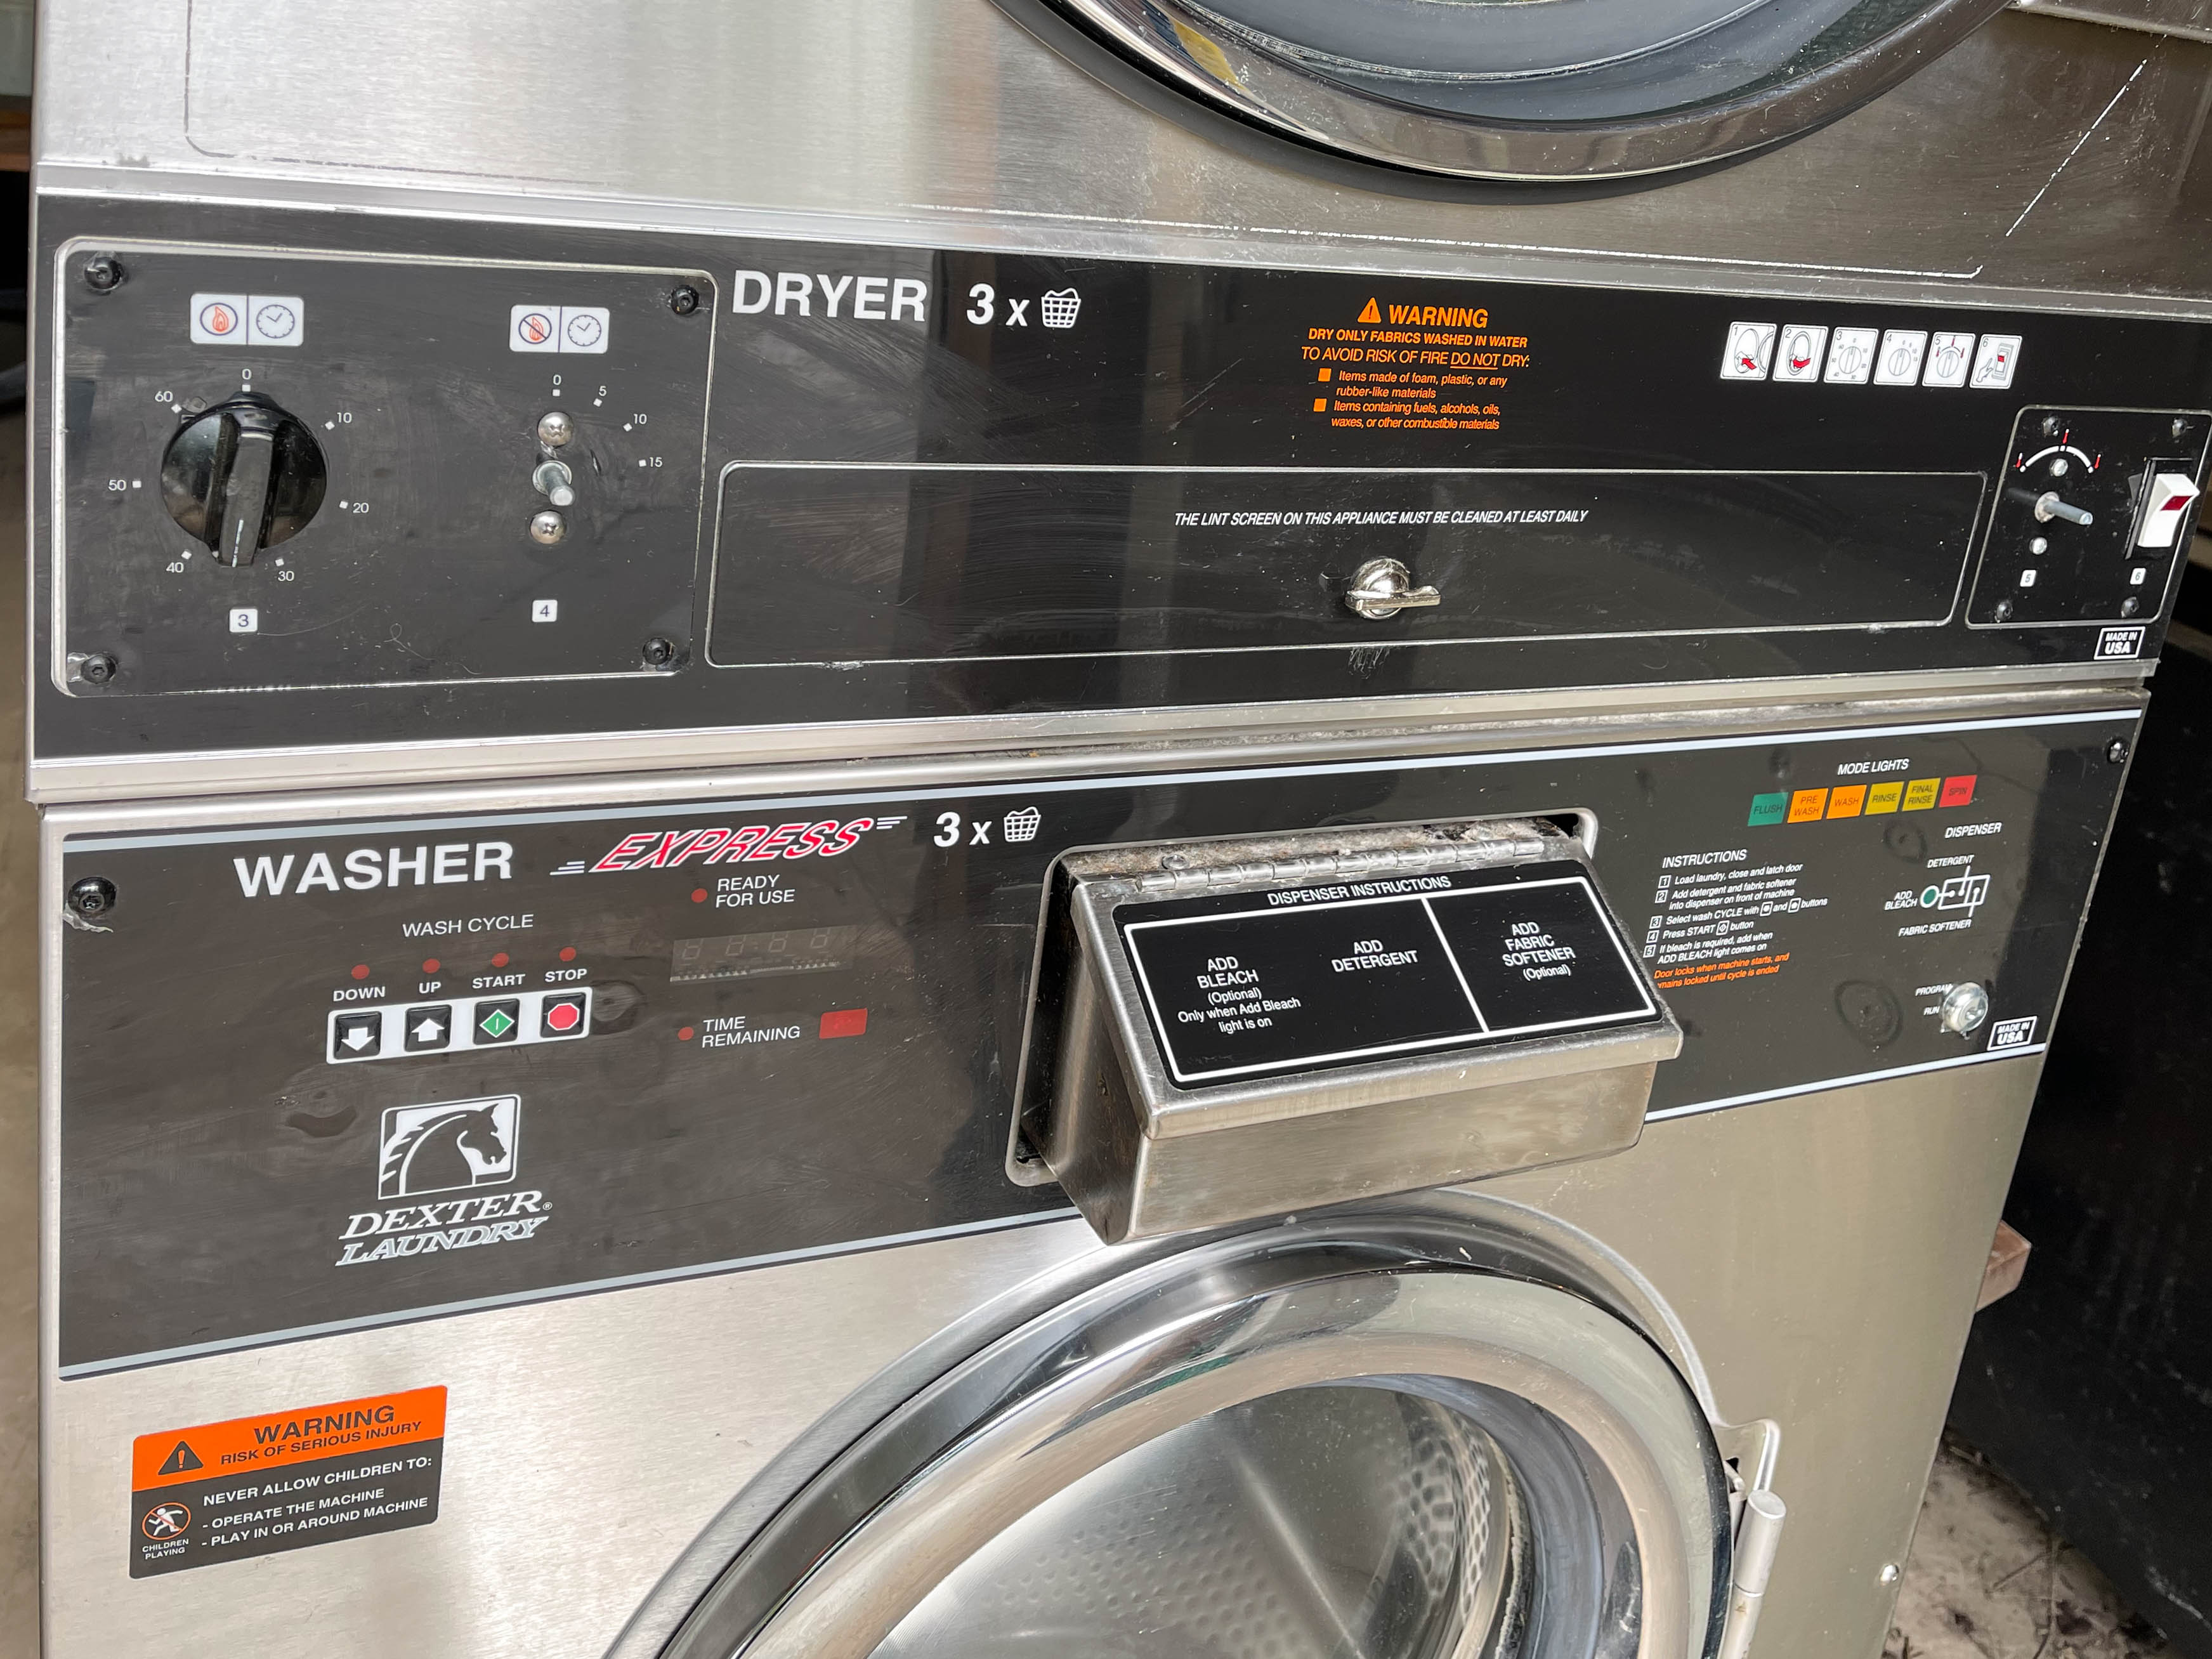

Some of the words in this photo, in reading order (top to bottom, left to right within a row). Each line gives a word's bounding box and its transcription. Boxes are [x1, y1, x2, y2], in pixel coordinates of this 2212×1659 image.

[733, 270, 927, 322] DRYER
[967, 283, 995, 325] 3
[1005, 298, 1030, 326] x
[1389, 304, 1488, 328] WARNING
[1308, 327, 1334, 340] DRY
[1336, 329, 1368, 341] ONLY
[1370, 331, 1421, 344] FABRICS
[1423, 332, 1473, 346] WASHED
[1474, 334, 1487, 346] IN
[1489, 335, 1528, 348] WATER
[1302, 346, 1320, 360] TO
[1321, 347, 1363, 362] AVOID
[1365, 349, 1397, 363] RISK
[1399, 350, 1418, 364] OF
[1420, 351, 1449, 364] FIRE
[1450, 351, 1471, 365] DO
[1472, 353, 1501, 366] NOT
[1502, 353, 1529, 367] DRY:
[242, 369, 251, 379] 0
[553, 375, 561, 385] 0
[1338, 370, 1366, 381] Items
[1368, 371, 1397, 383] made
[1399, 372, 1410, 383] of
[1411, 372, 1438, 385] foam,
[1441, 373, 1474, 386] plastic,
[1477, 376, 1488, 385] or
[1489, 377, 1508, 388] any
[155, 391, 173, 402] 60
[599, 385, 606, 397] 5
[1336, 386, 1389, 397] rubber-like
[1391, 389, 1436, 398] materials
[1333, 400, 1361, 412] Items
[1362, 402, 1412, 415] containing
[1413, 402, 1437, 414] fuels,
[1440, 403, 1480, 415] alcohols,
[1482, 404, 1500, 416] oils,
[337, 412, 352, 423] 10
[634, 414, 647, 424] 10
[1332, 418, 1364, 428] waxes,
[1366, 419, 1377, 428] or
[1377, 417, 1403, 428] other
[1403, 418, 1458, 429] combustible
[1458, 419, 1500, 430] materials
[649, 457, 662, 467] 15
[108, 480, 126, 490] 50
[353, 502, 369, 513] 20
[1175, 513, 1200, 525] THE
[1200, 513, 1231, 525] LINT
[1230, 512, 1283, 525] SCREEN
[1283, 512, 1303, 525] ON
[1305, 511, 1332, 525] THIS
[1332, 511, 1399, 524] APPLIANCE
[1398, 511, 1434, 524] MUST
[1432, 511, 1451, 523] BE
[1451, 510, 1503, 523] CLEANED
[1502, 510, 1521, 523] AT
[1519, 510, 1557, 522] LEAST
[1555, 510, 1588, 522] DAILY
[166, 561, 184, 573] 40
[278, 570, 294, 581] 30
[2025, 574, 2031, 583] 5
[2135, 572, 2141, 580] 6
[540, 605, 549, 617] 4
[238, 613, 249, 627] 3
[2105, 632, 2128, 641] MADE
[2128, 631, 2138, 640] IN
[2105, 641, 2130, 654] USA
[1837, 761, 1871, 775] MODE
[1871, 758, 1909, 772] LIGHTS
[1911, 785, 1933, 793] FINAL
[1948, 787, 1967, 796] SPIN
[1800, 796, 1817, 804] PRE
[1835, 797, 1859, 806] WASH
[1872, 793, 1897, 802] RINSE
[1908, 794, 1932, 804] RINSE
[1753, 803, 1783, 814] FLUSH
[1794, 806, 1819, 816] WASH
[934, 811, 960, 847] 3
[969, 821, 992, 845] x
[1945, 822, 2002, 838] DISPENSER
[589, 818, 875, 872] EXPRESS
[1662, 849, 1747, 869] INSTRUCTIONS
[1927, 855, 1974, 868] DETERGENT
[230, 838, 513, 897] WASHER
[1674, 874, 1696, 884] Load
[1728, 870, 1749, 879] close
[1750, 867, 1765, 877] and
[1765, 865, 1784, 874] latch
[1784, 863, 1803, 872] door
[717, 874, 780, 891] READY
[1267, 886, 1350, 905] DISPENSER
[1350, 875, 1451, 896] INSTRUCTIONS
[1672, 889, 1689, 899] Add
[1689, 885, 1727, 897] detergent
[1727, 882, 1743, 893] and
[1743, 881, 1765, 892] fabric
[1765, 878, 1796, 890] softener
[716, 893, 753, 908] FOR
[759, 889, 795, 904] USE
[1894, 890, 1913, 900] ADD
[1885, 898, 1918, 910] BLEACH
[402, 919, 461, 937] WASH
[468, 914, 533, 932] CYCLE
[1512, 922, 1540, 936] ADD
[1663, 929, 1685, 939] Press
[1686, 924, 1716, 936] START
[1730, 921, 1754, 931] button
[1899, 925, 1928, 936] FABRIC
[1928, 919, 1972, 933] SOFTENER
[1354, 940, 1383, 954] ADD
[1505, 934, 1554, 951] FABRIC
[1208, 956, 1238, 971] ADD
[1331, 950, 1418, 972] DETERGENT
[1502, 947, 1576, 966] SOFTENER
[545, 968, 587, 982] STOP
[1196, 969, 1259, 988] BLEACH
[1522, 964, 1571, 981] (Optional)
[419, 981, 441, 993] UP
[472, 973, 525, 988] START
[333, 986, 385, 1001] DOWN
[1208, 987, 1262, 1006] (Optional)
[1177, 1009, 1204, 1023] Only
[1206, 1007, 1238, 1018] when
[1240, 1001, 1262, 1014] Add
[1262, 997, 1301, 1011] Bleach
[1923, 1006, 1940, 1015] RUN
[703, 1016, 745, 1032] TIME
[1218, 1020, 1244, 1034] light
[1243, 1019, 1255, 1029] is
[1257, 1018, 1273, 1027] on
[702, 1025, 800, 1048] REMAINING
[335, 1216, 549, 1266] LAUNDRY
[254, 1405, 394, 1444] WARNING
[221, 1449, 259, 1465] RISK
[264, 1445, 286, 1457] OF
[291, 1432, 361, 1452] SERIOUS
[366, 1421, 421, 1439] INJURY
[204, 1487, 258, 1506] NEVER
[262, 1475, 320, 1495] ALLOW
[324, 1461, 402, 1484] CHILDREN
[406, 1457, 431, 1469] TO:
[212, 1507, 282, 1528] OPERATE
[285, 1500, 315, 1514] THE
[318, 1488, 384, 1509] MACHINE
[211, 1530, 250, 1546] PLAY
[254, 1526, 268, 1538] IN
[272, 1522, 294, 1534] OR
[297, 1510, 360, 1530] AROUND
[363, 1497, 428, 1518] MACHINE
[142, 1538, 188, 1552] CHILDREN
[145, 1547, 185, 1559] PLAYING
